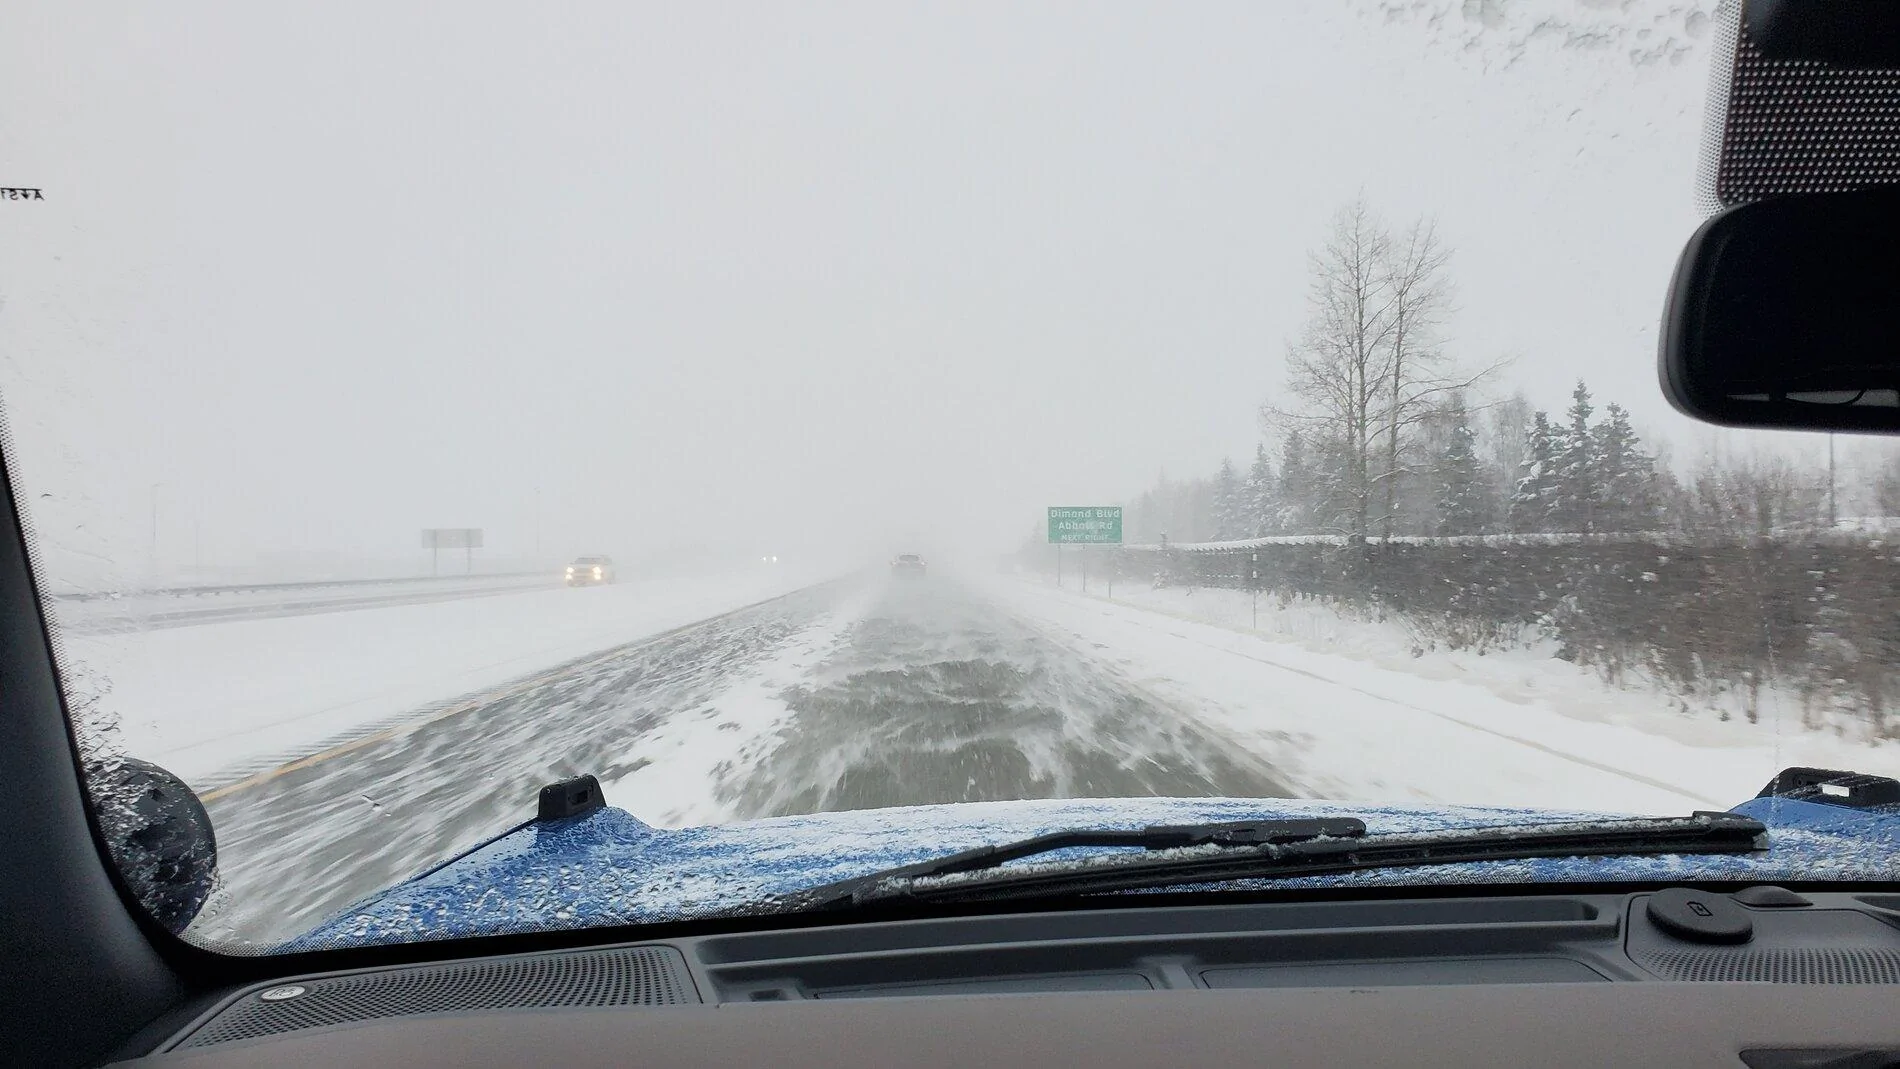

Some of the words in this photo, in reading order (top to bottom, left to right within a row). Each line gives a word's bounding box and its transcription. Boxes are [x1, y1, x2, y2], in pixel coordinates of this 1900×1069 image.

[1051, 509, 1091, 518] Dimond
[1096, 509, 1120, 518] Blvd
[1099, 521, 1113, 530] Rd
